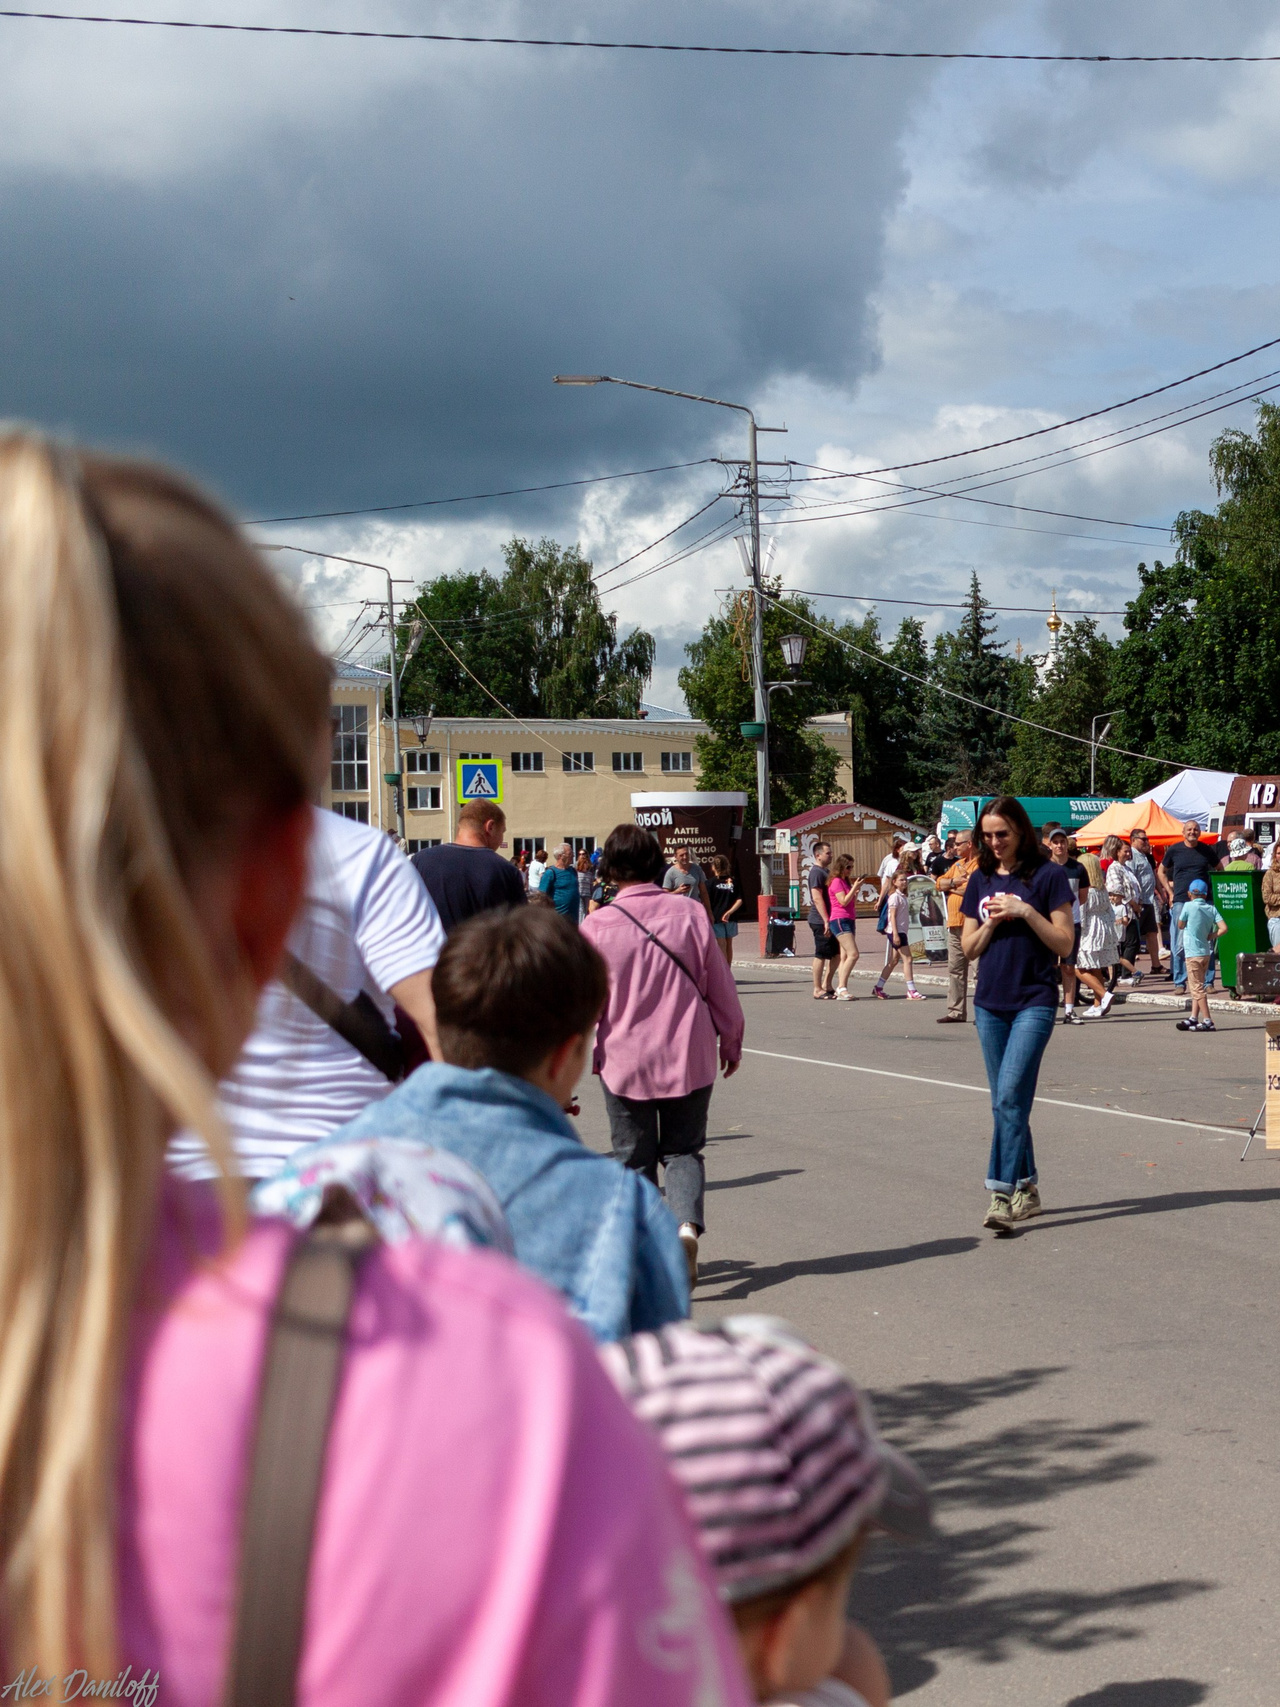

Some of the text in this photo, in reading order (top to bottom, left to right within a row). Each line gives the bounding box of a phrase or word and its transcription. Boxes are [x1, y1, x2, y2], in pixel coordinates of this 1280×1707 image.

[1070, 800, 1124, 811] STREETFO
[666, 837, 714, 845] КАПУЧИНО
[663, 846, 717, 854] АМКАНО
